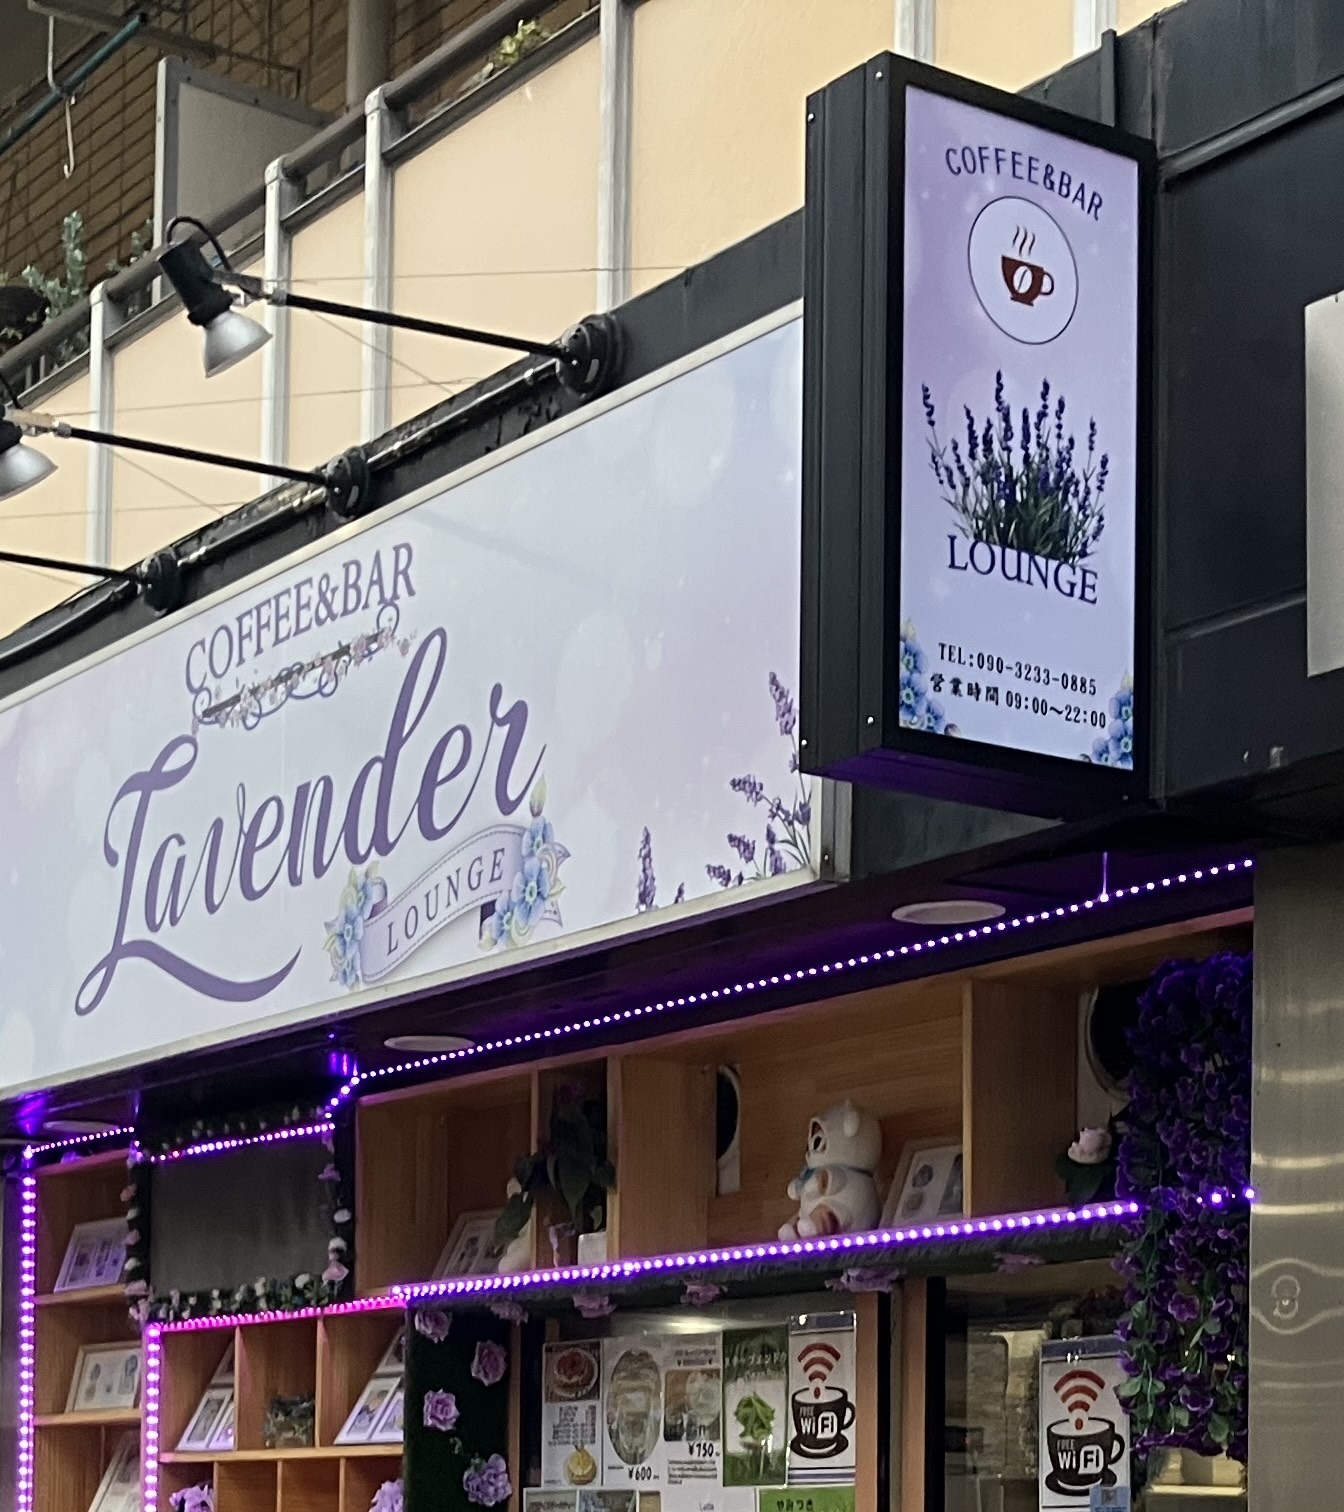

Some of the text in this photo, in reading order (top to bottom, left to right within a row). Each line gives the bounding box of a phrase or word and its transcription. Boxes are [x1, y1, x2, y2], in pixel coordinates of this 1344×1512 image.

[945, 146, 1103, 221] COFFEE&BAR
[947, 535, 1099, 605] LOUNGE
[184, 541, 417, 694] COFFEE&BAR
[930, 673, 999, 706] 営業時間
[75, 627, 548, 1017] Lavender
[386, 847, 506, 957] LOUNGE
